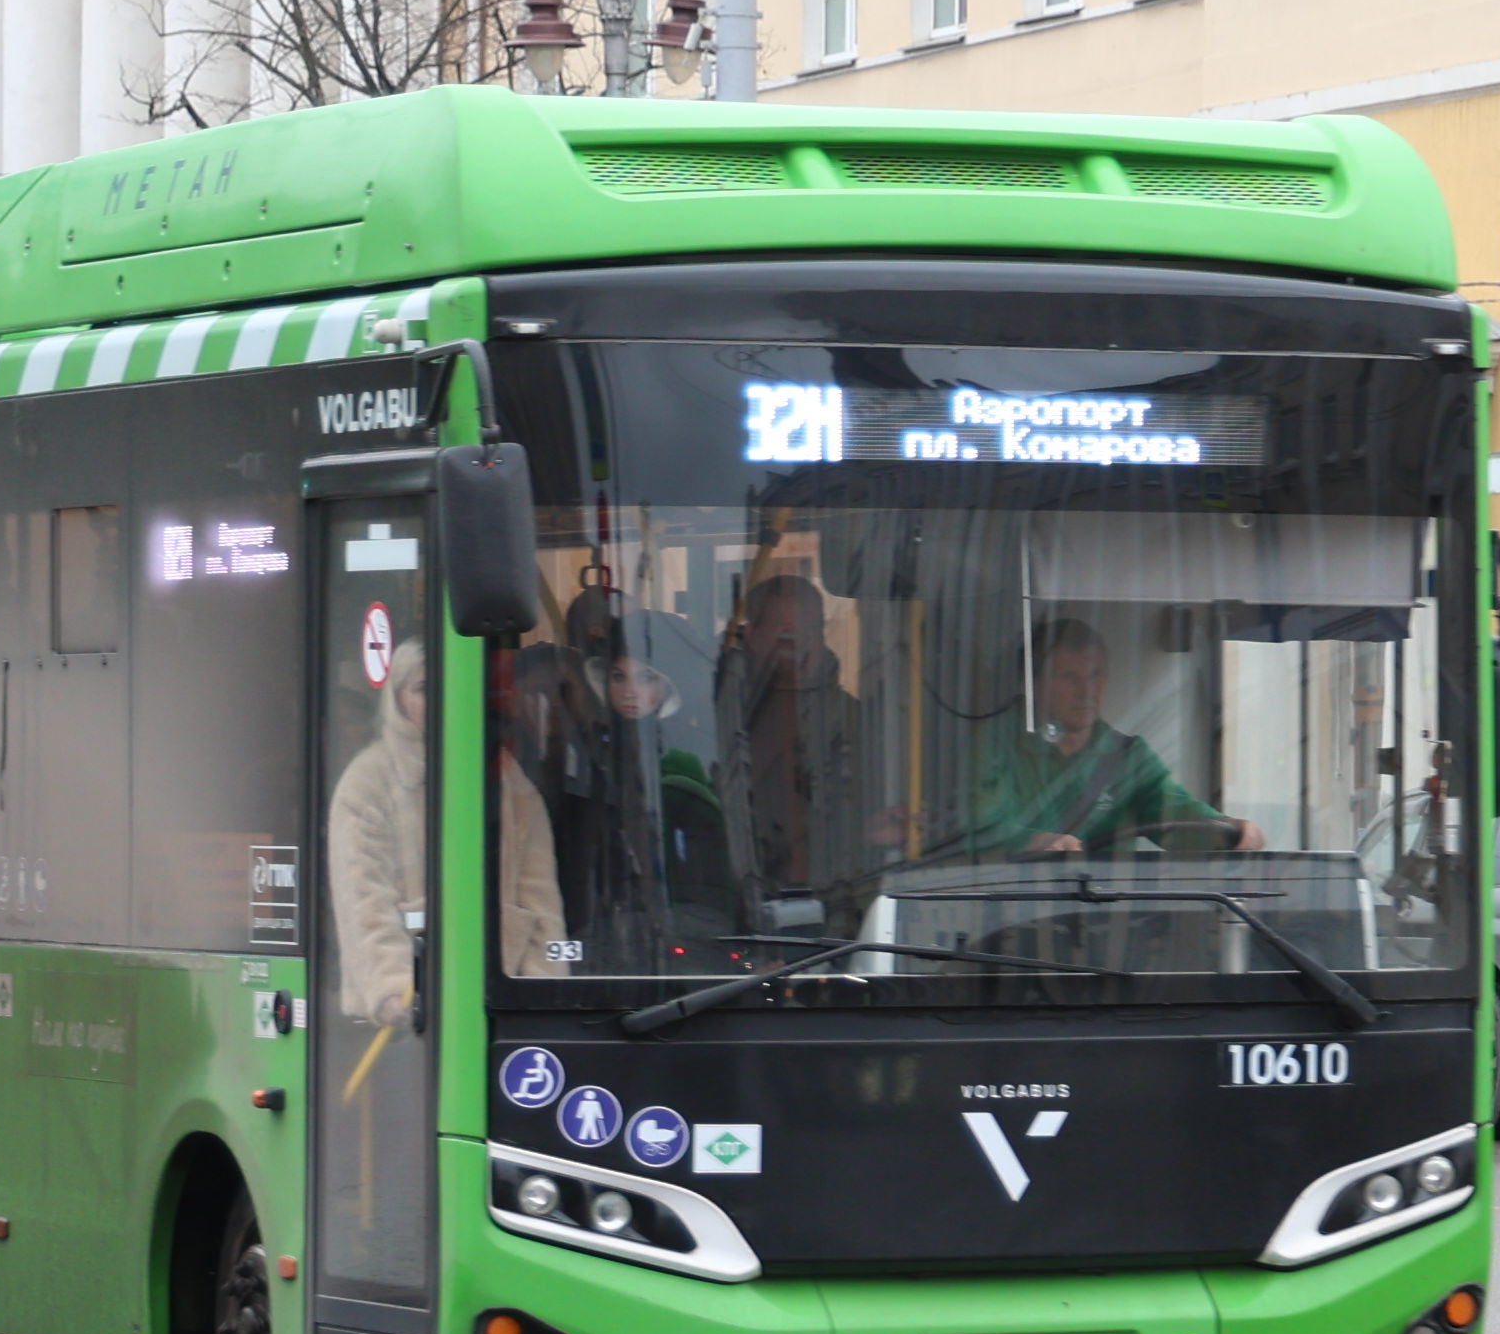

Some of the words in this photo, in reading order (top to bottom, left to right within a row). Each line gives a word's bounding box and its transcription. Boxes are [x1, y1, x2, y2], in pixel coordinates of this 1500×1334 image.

[103, 149, 239, 216] МЕТАН
[952, 386, 1152, 430] Аэропорт
[902, 430, 980, 461] пл.
[547, 942, 576, 960] 93
[1228, 1043, 1349, 1084] 10610
[960, 1084, 1071, 1098] VOLGABUS
